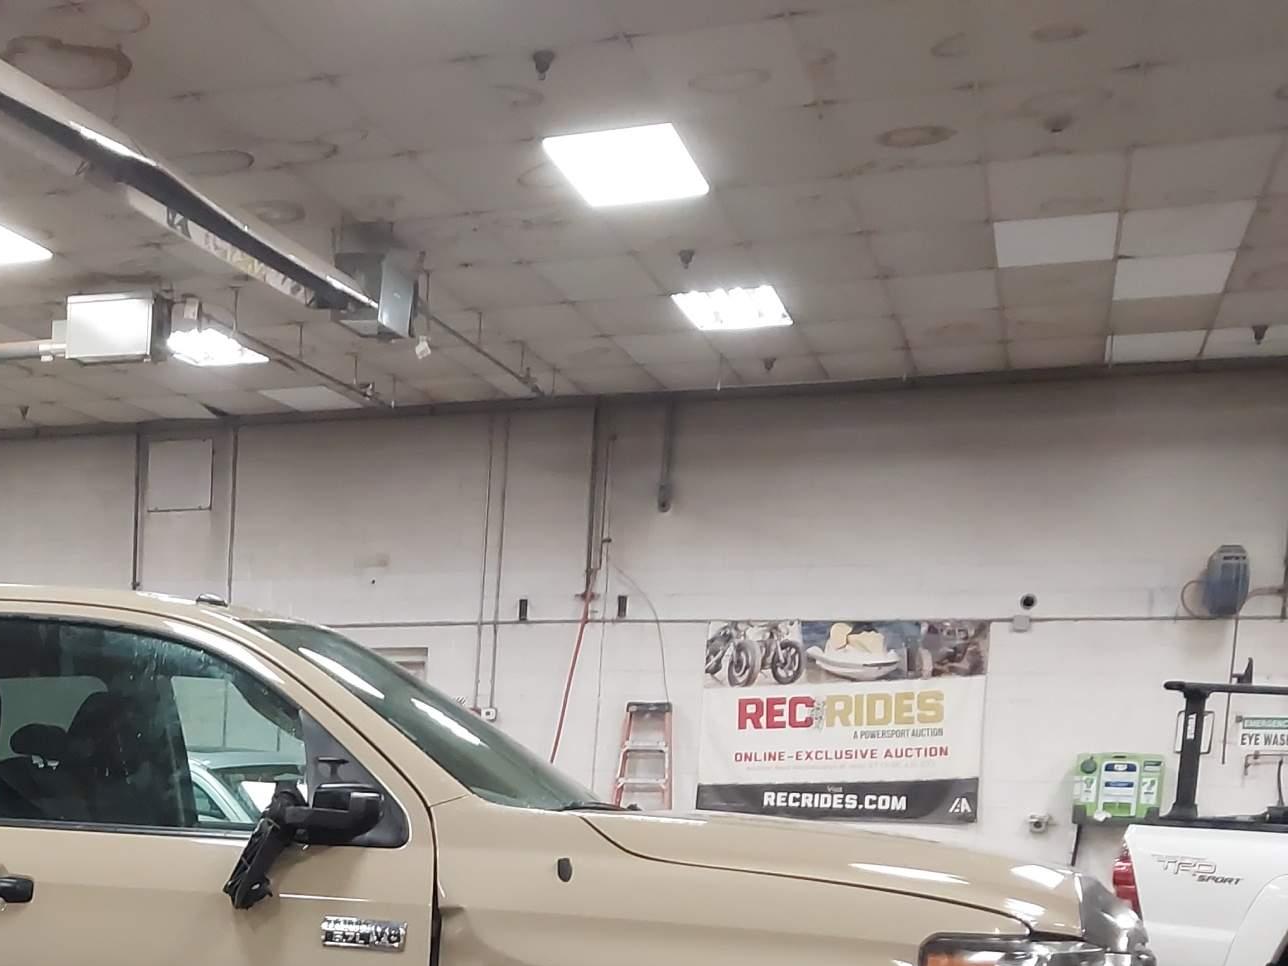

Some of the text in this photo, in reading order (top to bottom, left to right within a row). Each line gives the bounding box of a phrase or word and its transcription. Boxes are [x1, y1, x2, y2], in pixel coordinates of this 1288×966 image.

[738, 690, 945, 730] REC RIDES
[853, 728, 944, 740] A POWERSPORT AUCTION
[1241, 733, 1261, 746] EYE
[734, 746, 949, 762] ONLINE-EXCLUSIVE AUCTION
[763, 791, 907, 811] RECRIDES.COM
[1197, 875, 1242, 885] SPORT
[373, 925, 402, 944] V8
